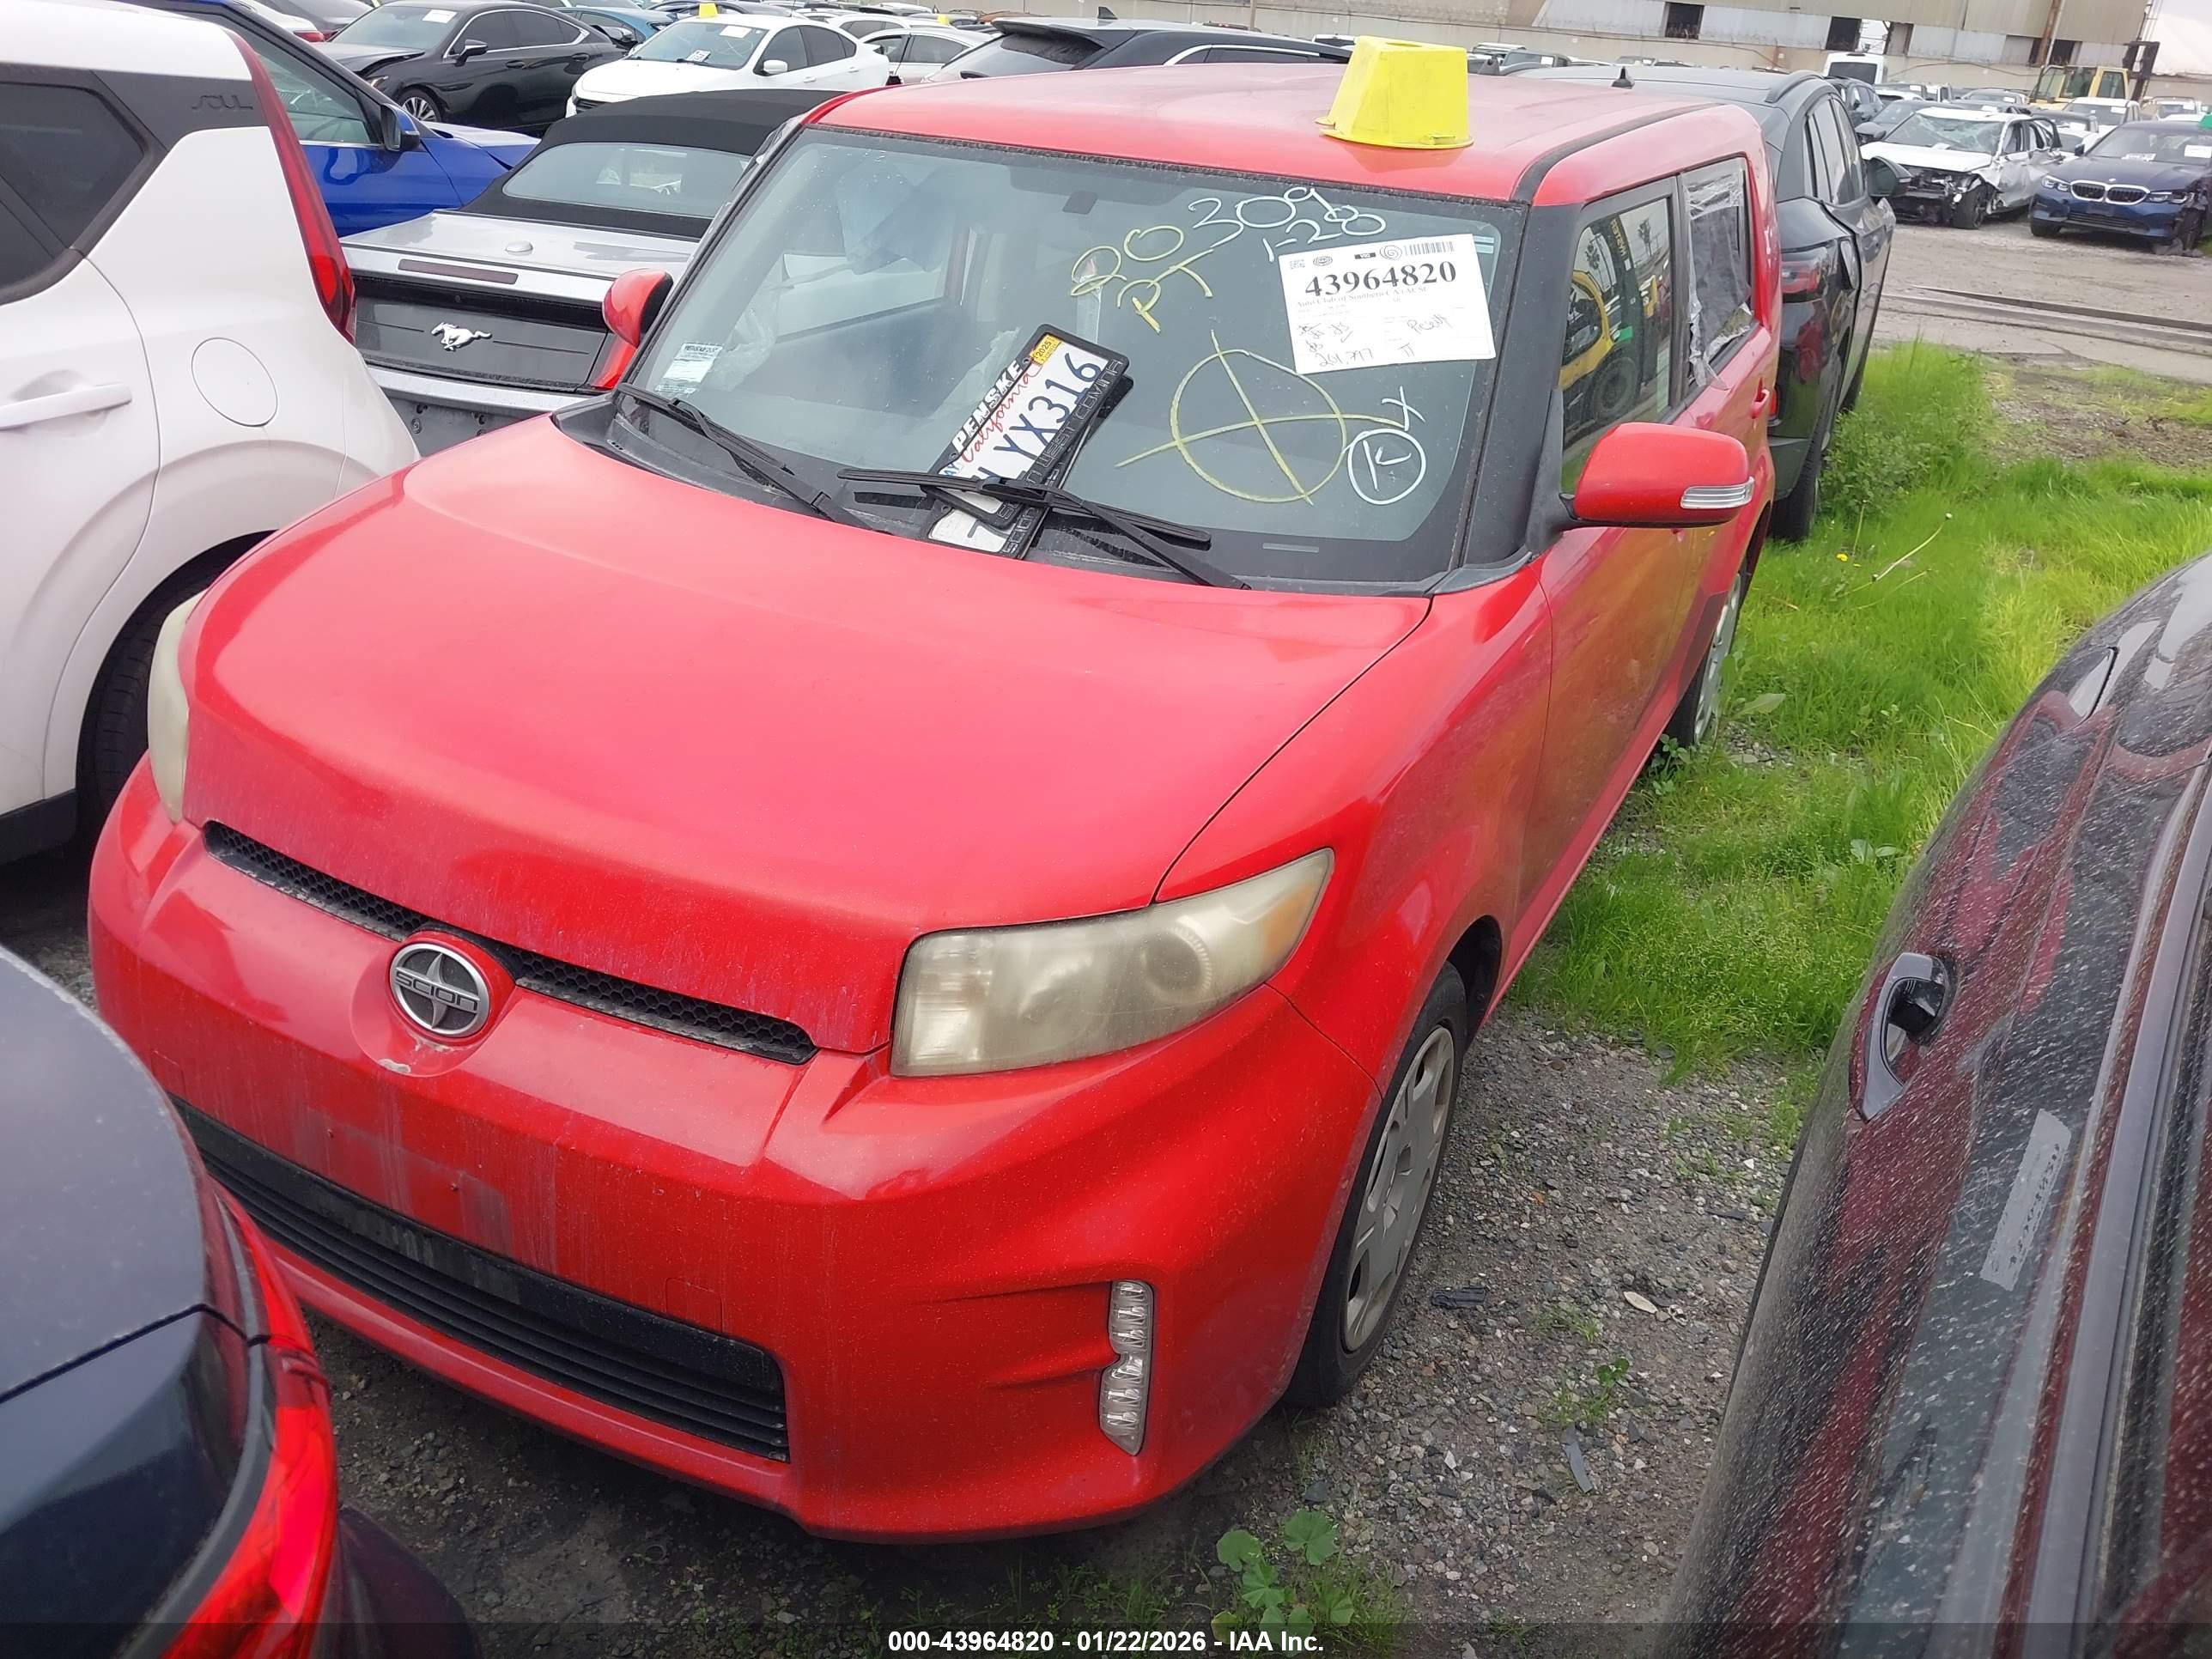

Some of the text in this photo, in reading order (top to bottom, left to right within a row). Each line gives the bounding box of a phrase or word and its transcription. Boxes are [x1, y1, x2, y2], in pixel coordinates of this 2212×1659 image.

[1305, 261, 1456, 297] 43964820
[1036, 340, 1052, 357] 2025
[951, 360, 1024, 453] PENSKE
[959, 364, 1043, 464] California
[1036, 422, 1076, 468] WEST
[1073, 359, 1124, 420] COVINA
[396, 970, 478, 1012] SCION
